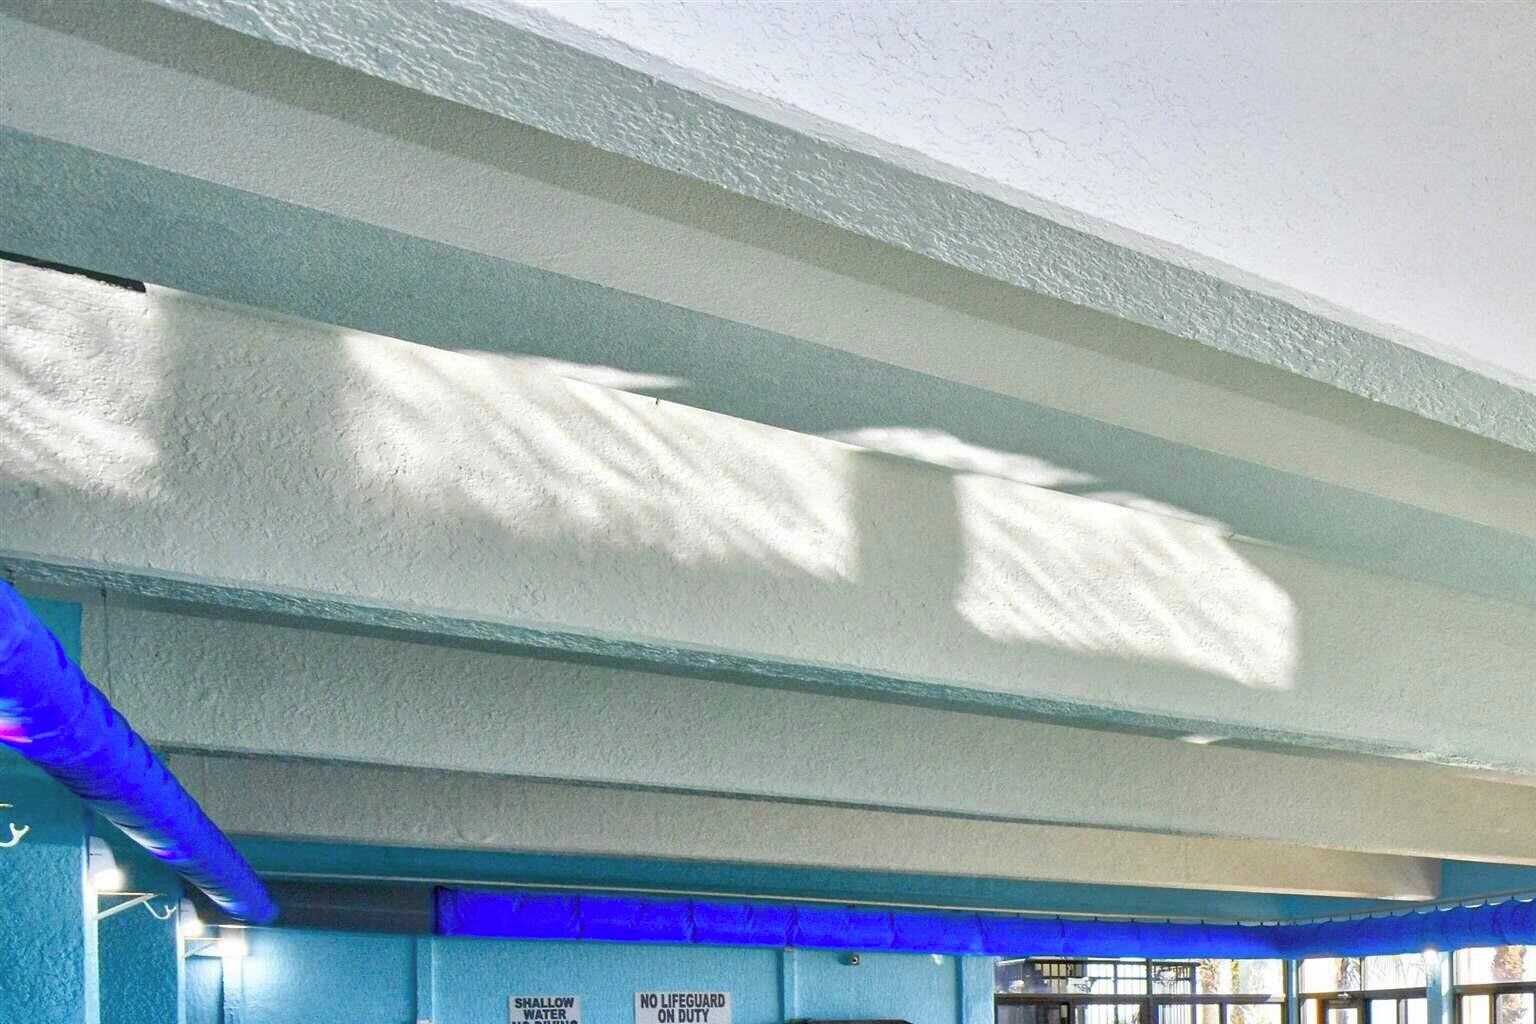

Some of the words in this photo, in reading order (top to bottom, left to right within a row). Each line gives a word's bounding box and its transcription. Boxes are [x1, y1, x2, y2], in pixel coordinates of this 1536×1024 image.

[514, 997, 575, 1009] SHALLOW
[640, 993, 658, 1009] NO
[661, 993, 726, 1009] LIFEGUARD
[523, 1008, 567, 1020] WATER
[657, 1008, 675, 1023] ON
[678, 1008, 709, 1023] DUTY
